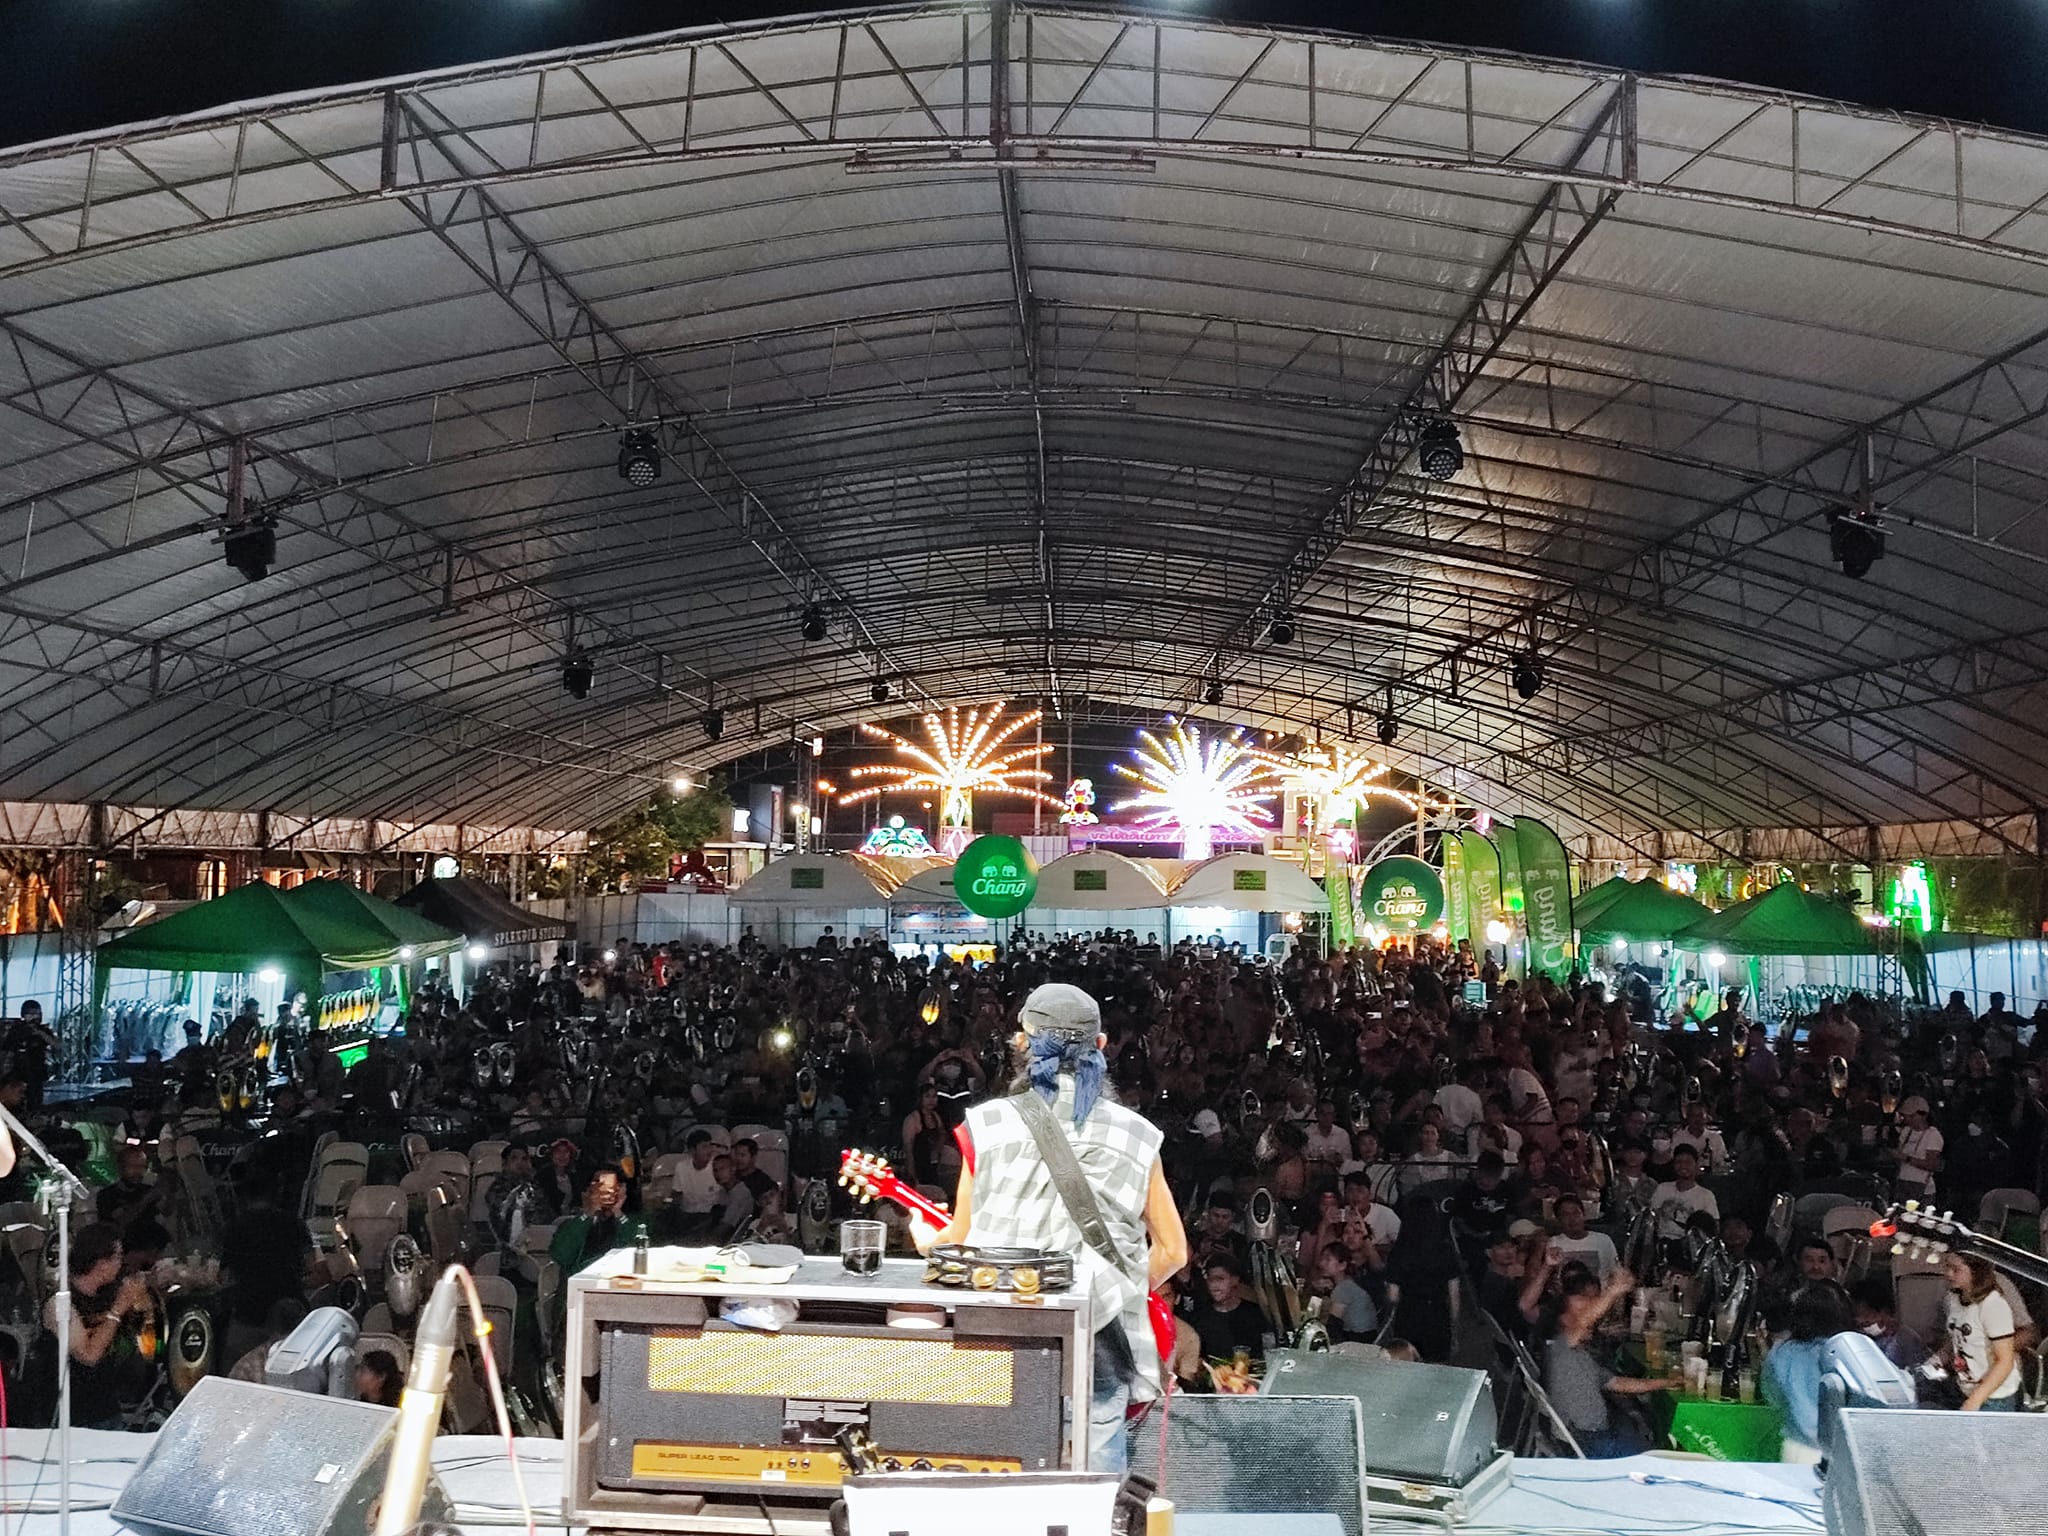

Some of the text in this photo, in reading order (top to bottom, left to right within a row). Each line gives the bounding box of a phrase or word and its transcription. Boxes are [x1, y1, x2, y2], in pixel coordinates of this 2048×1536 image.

[972, 878, 1027, 897] Chang
[1373, 899, 1428, 917] Chang
[1533, 885, 1571, 969] Chang
[657, 1452, 688, 1460] SUPER
